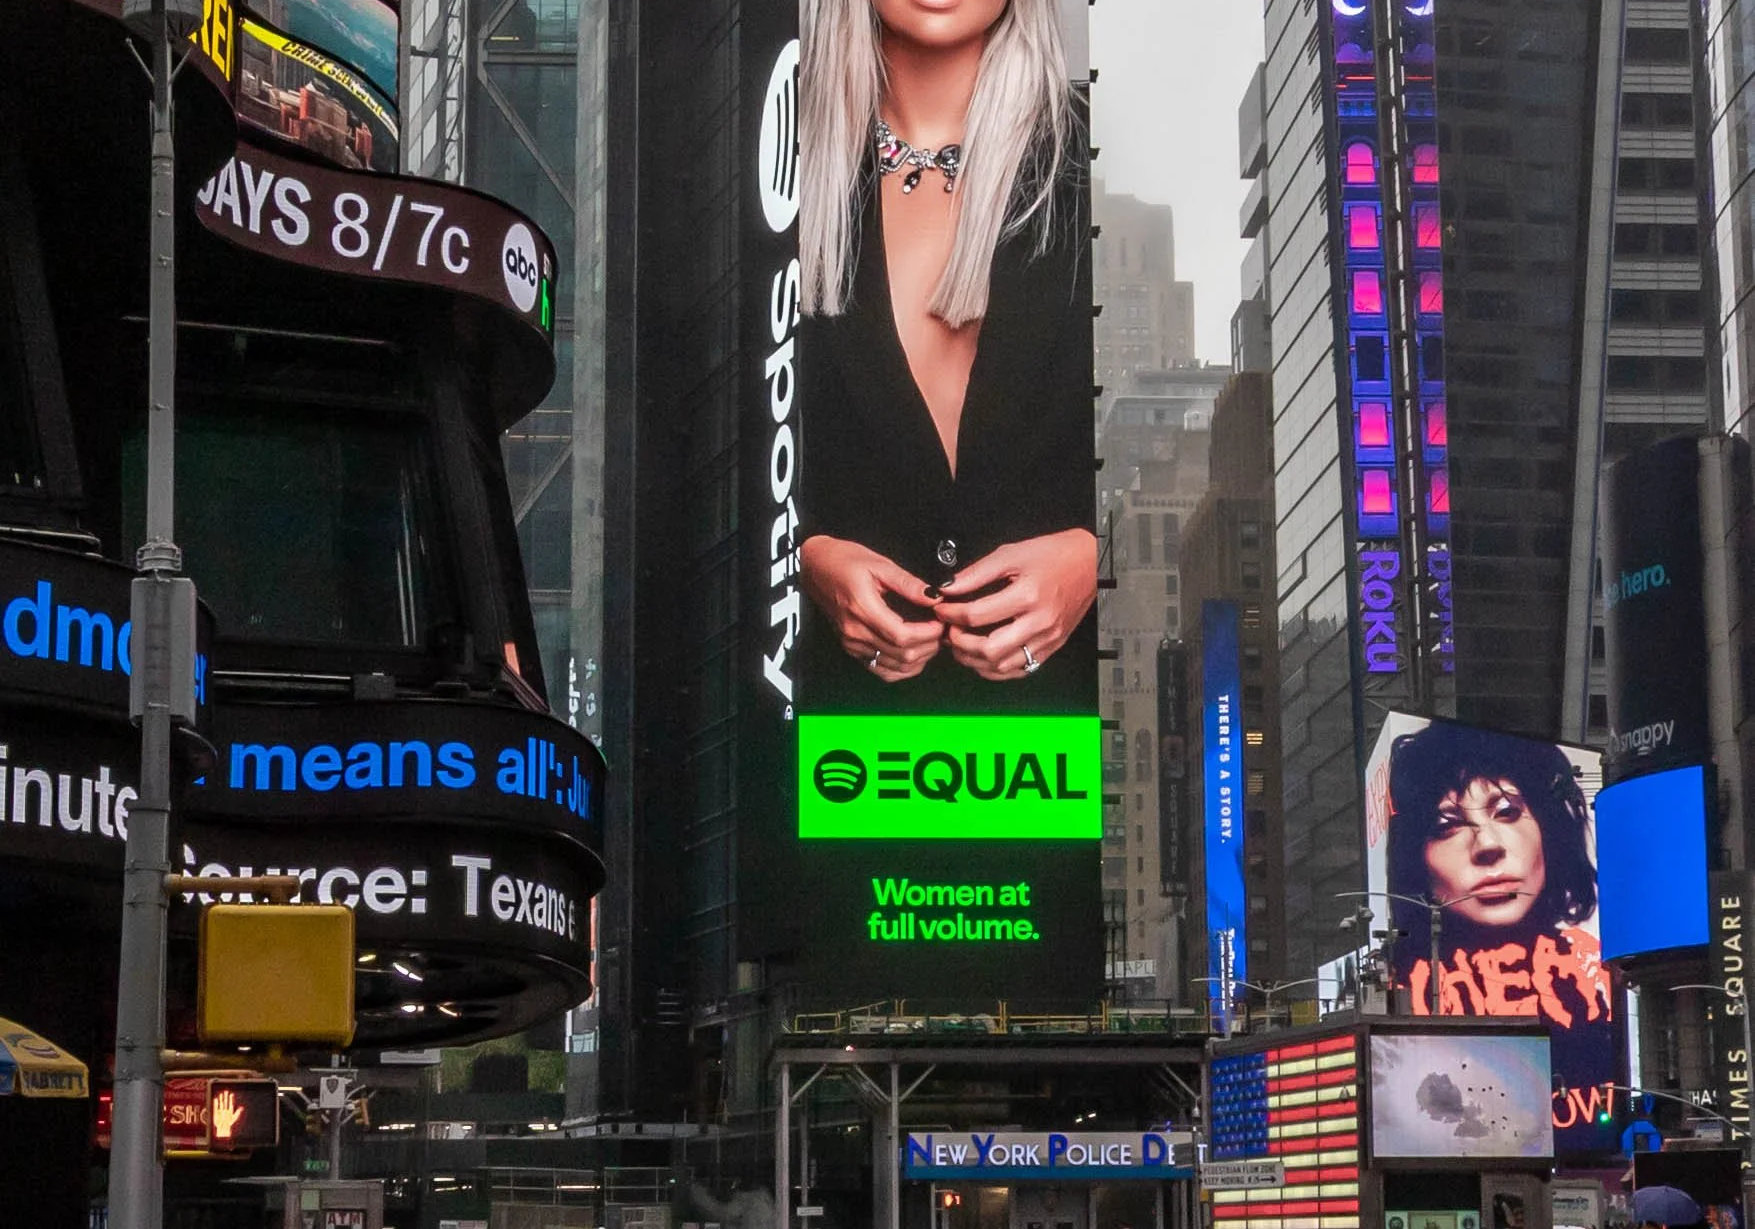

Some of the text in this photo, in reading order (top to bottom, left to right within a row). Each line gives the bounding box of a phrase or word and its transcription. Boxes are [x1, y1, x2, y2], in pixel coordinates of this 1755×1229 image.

[331, 192, 470, 274] 8/7c
[505, 246, 536, 287] abc
[230, 739, 476, 791] means
[878, 751, 1087, 804] EQUAL
[1218, 694, 1232, 844] THERE'S A STORY.
[451, 854, 565, 936] Texans
[868, 911, 1040, 941] full volume.
[871, 878, 1031, 907] Women at
[1720, 895, 1745, 1016] SQUARE
[1727, 1048, 1751, 1141] TIMES
[908, 1133, 1208, 1167] NEW YORK POLICE DET
